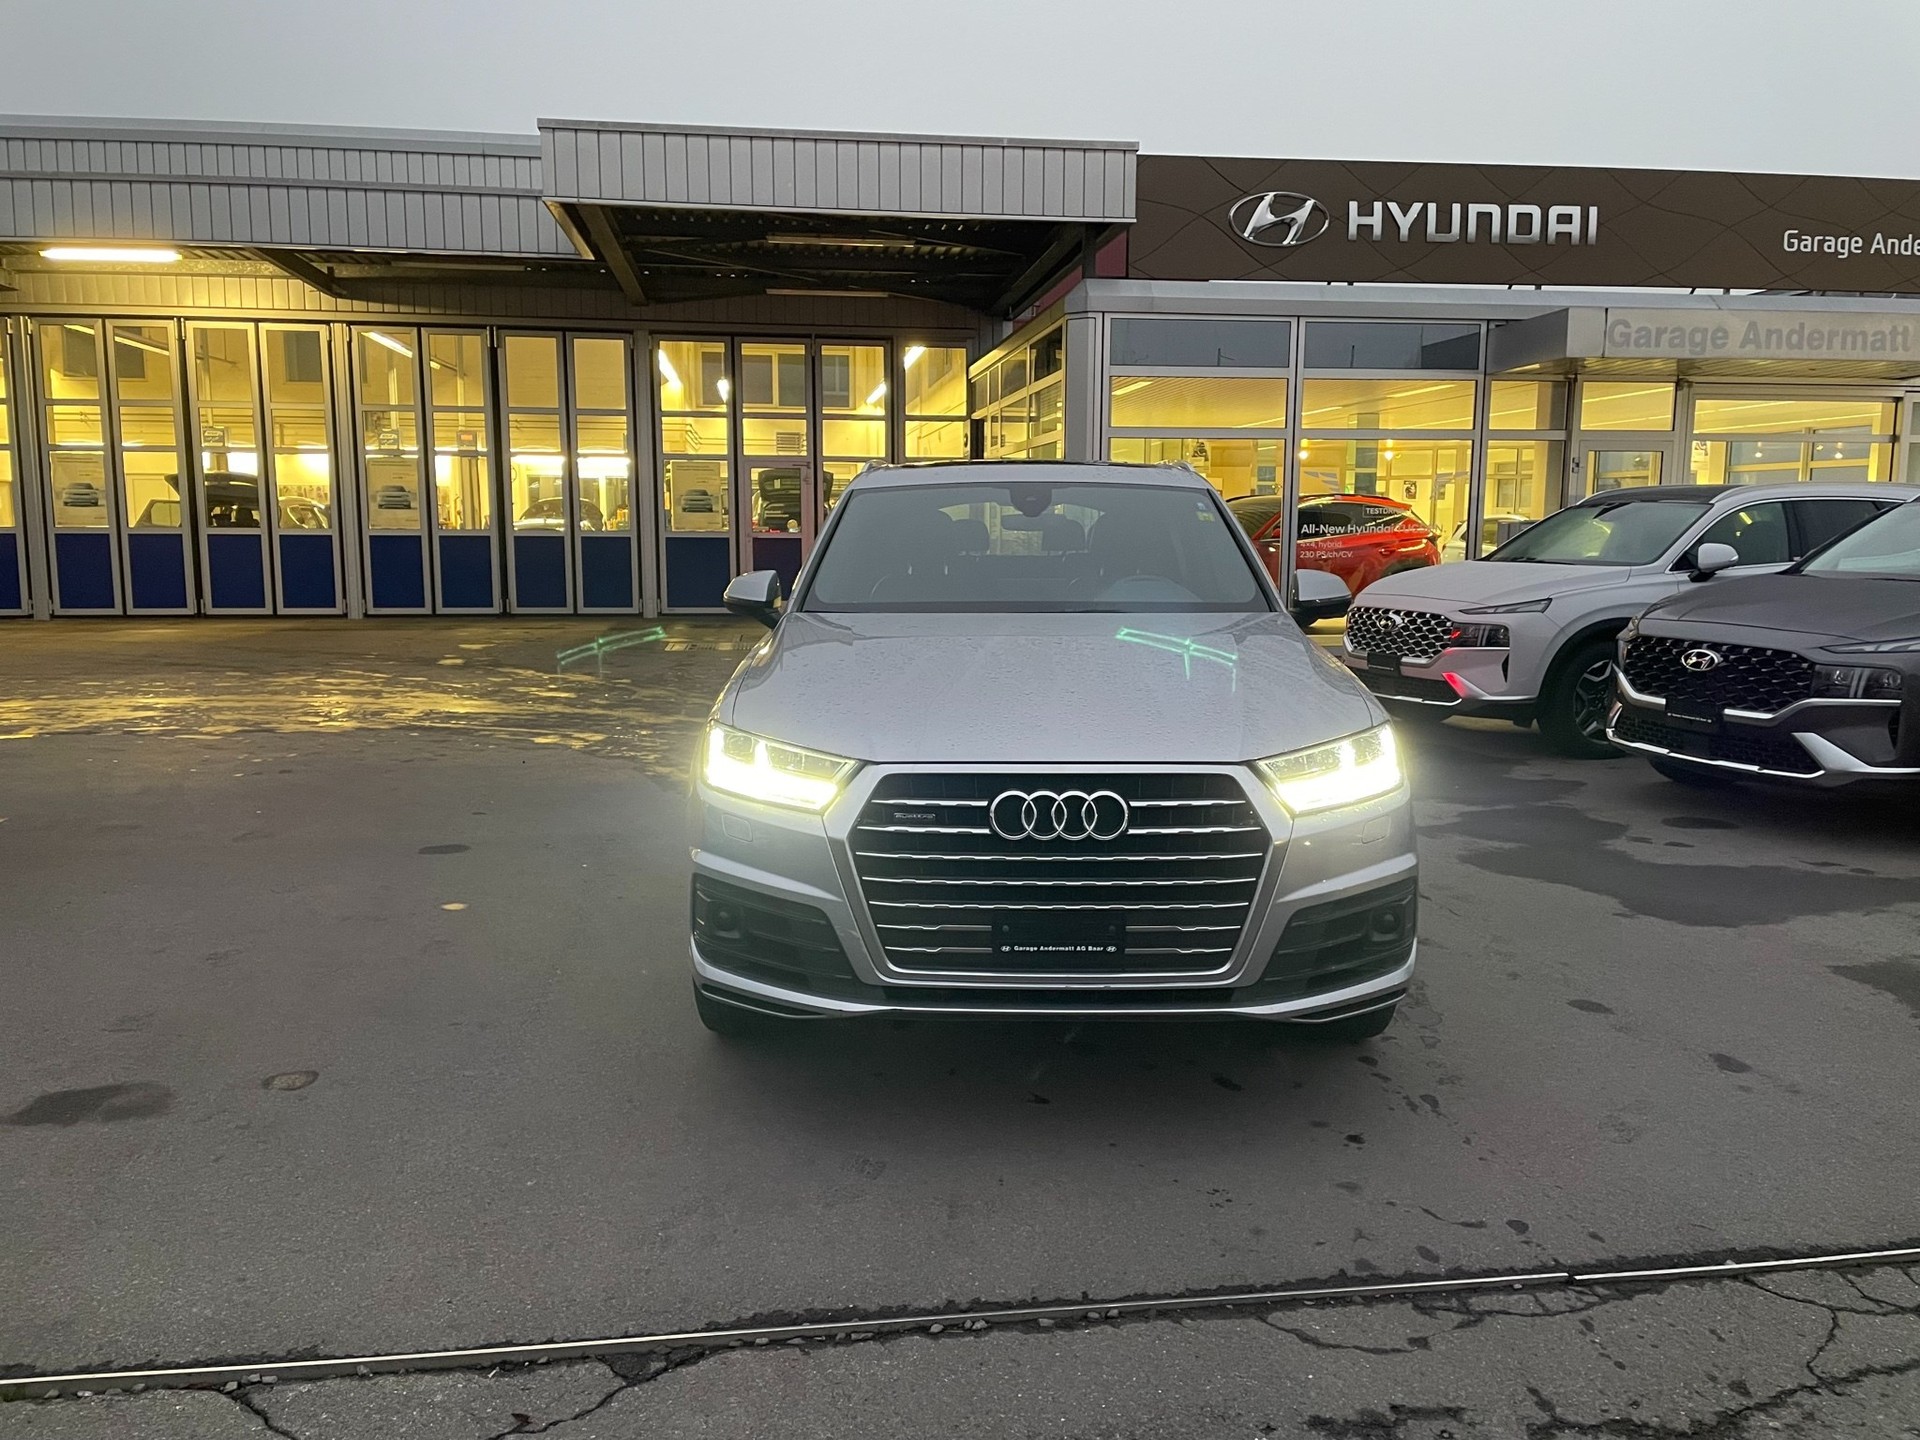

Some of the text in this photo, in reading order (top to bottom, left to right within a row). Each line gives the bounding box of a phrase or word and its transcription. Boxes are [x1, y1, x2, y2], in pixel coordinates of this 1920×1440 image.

[1347, 200, 1599, 246] HYUNDAI
[1783, 229, 1863, 259] Garage
[1607, 318, 1912, 356] Garage Andermatt
[1301, 523, 1345, 534] All-New
[1347, 523, 1394, 536] Hyundai
[1300, 550, 1315, 558] 230
